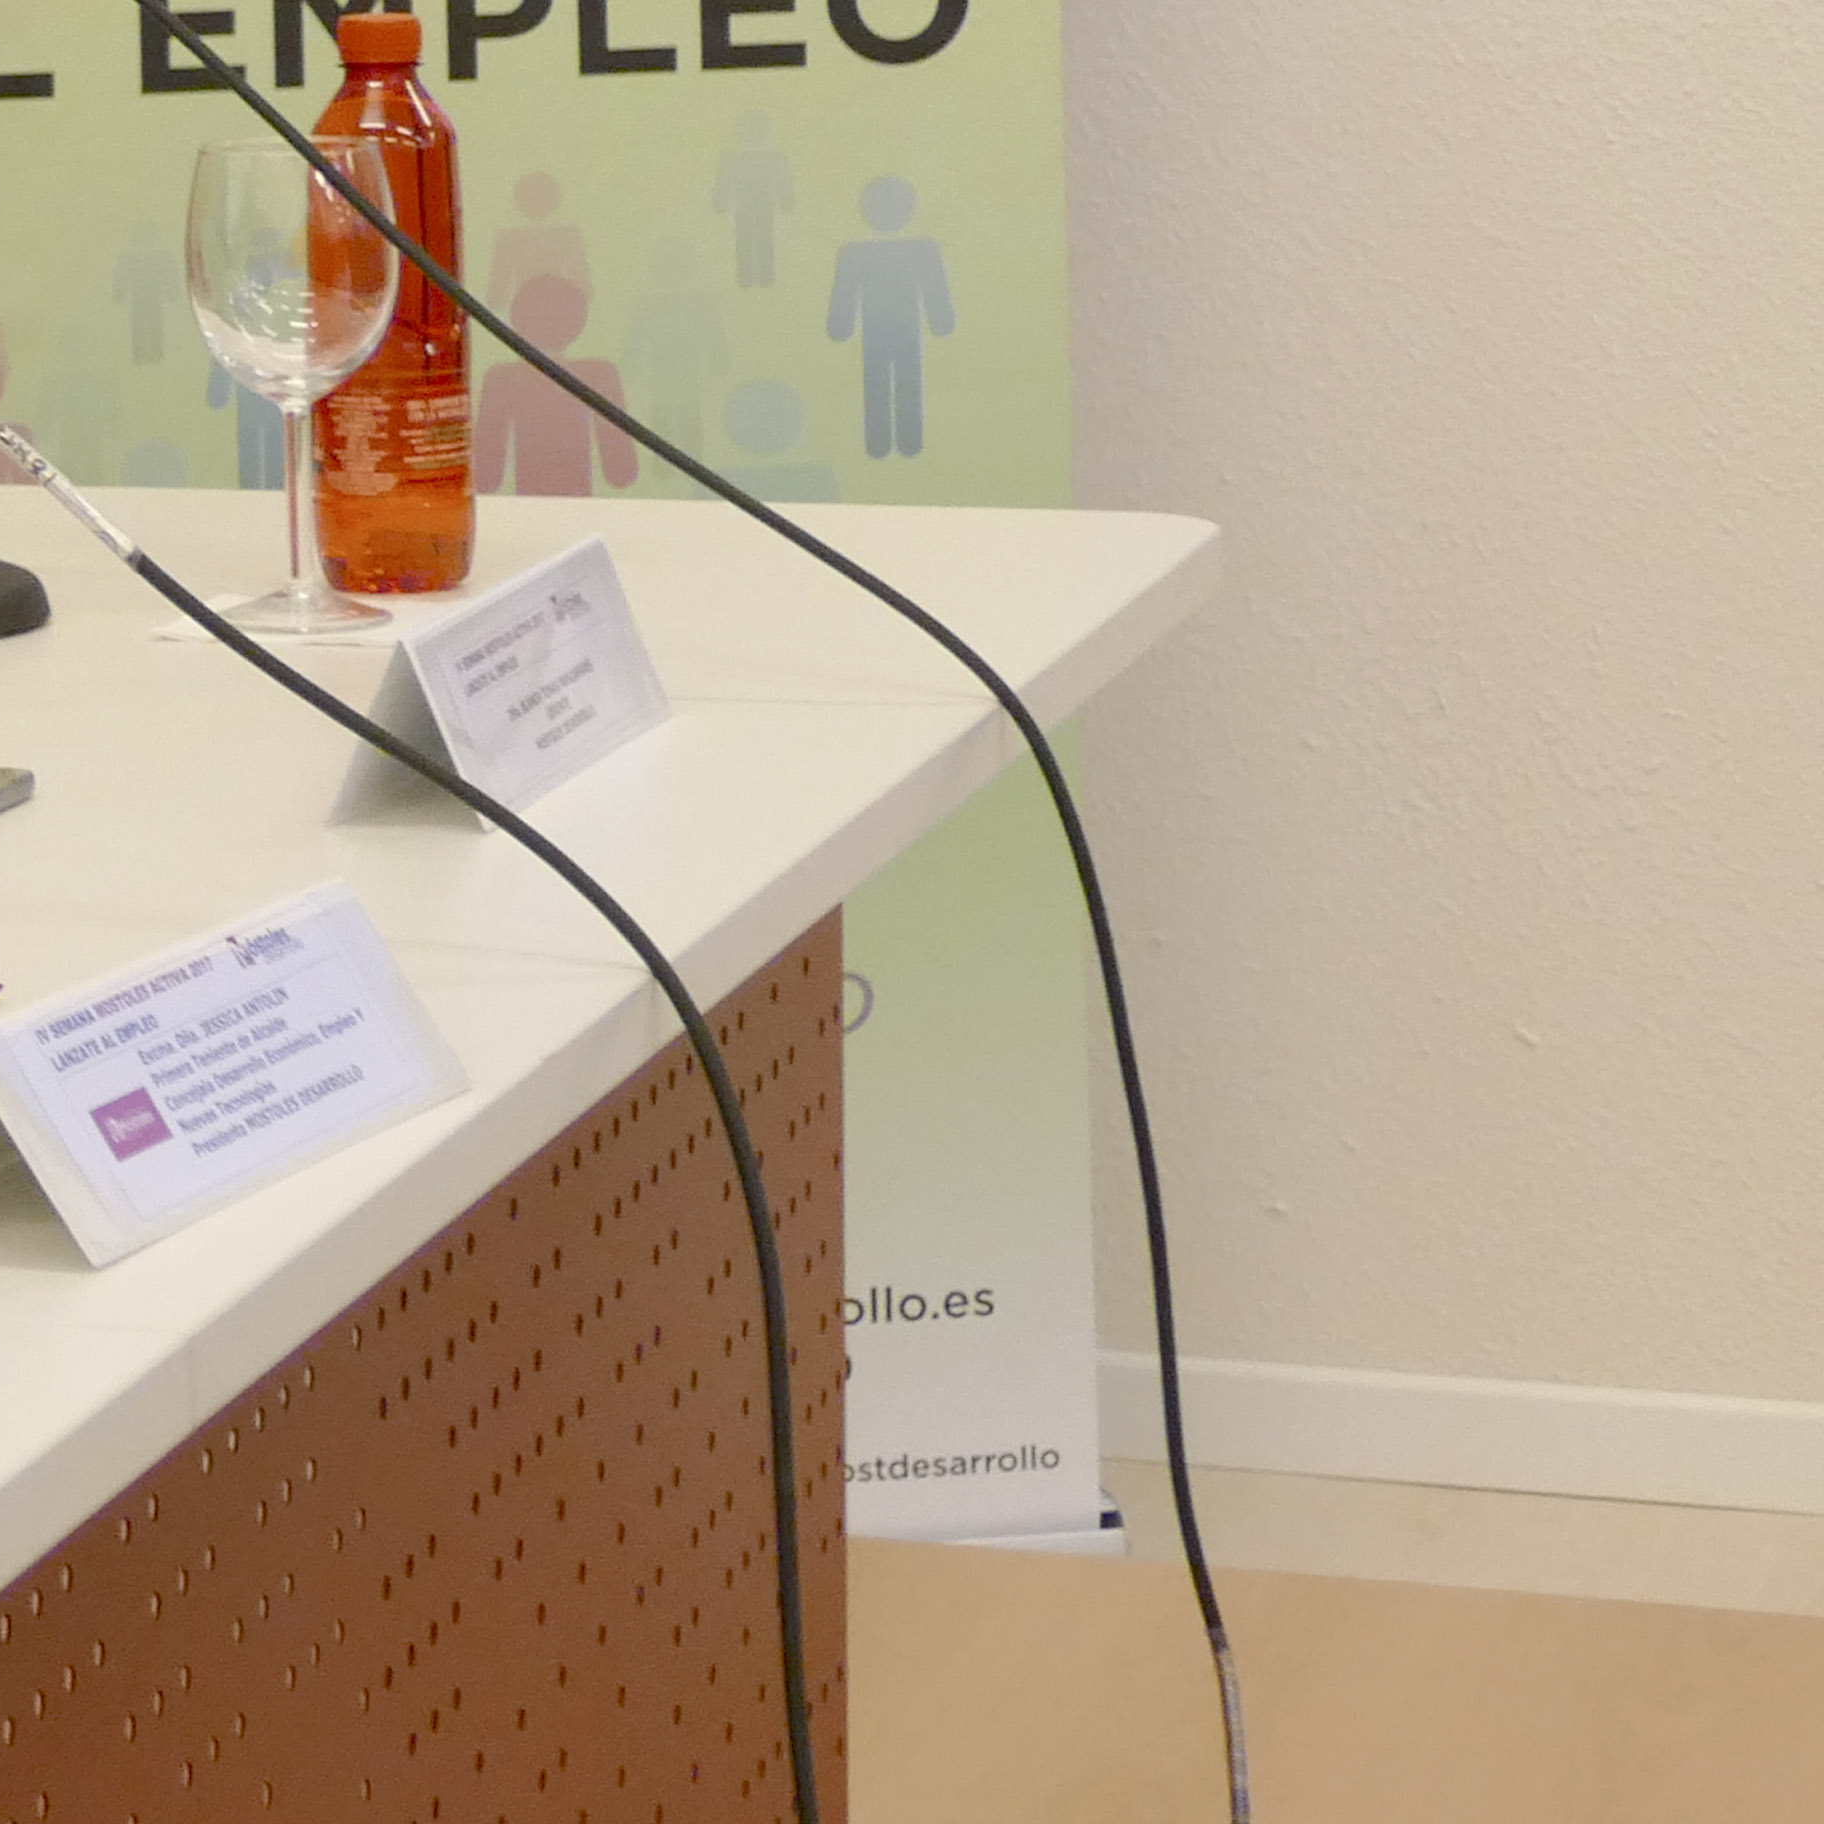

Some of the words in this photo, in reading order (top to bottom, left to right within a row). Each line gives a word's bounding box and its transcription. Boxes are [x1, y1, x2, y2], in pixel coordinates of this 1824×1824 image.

[48, 1008, 97, 1039] SEMANA
[148, 967, 191, 995] ACTIVA
[187, 955, 214, 979] 2017
[100, 1033, 118, 1050] AL
[114, 1013, 159, 1044] EMPLEO
[199, 1007, 244, 1038] JESSICA
